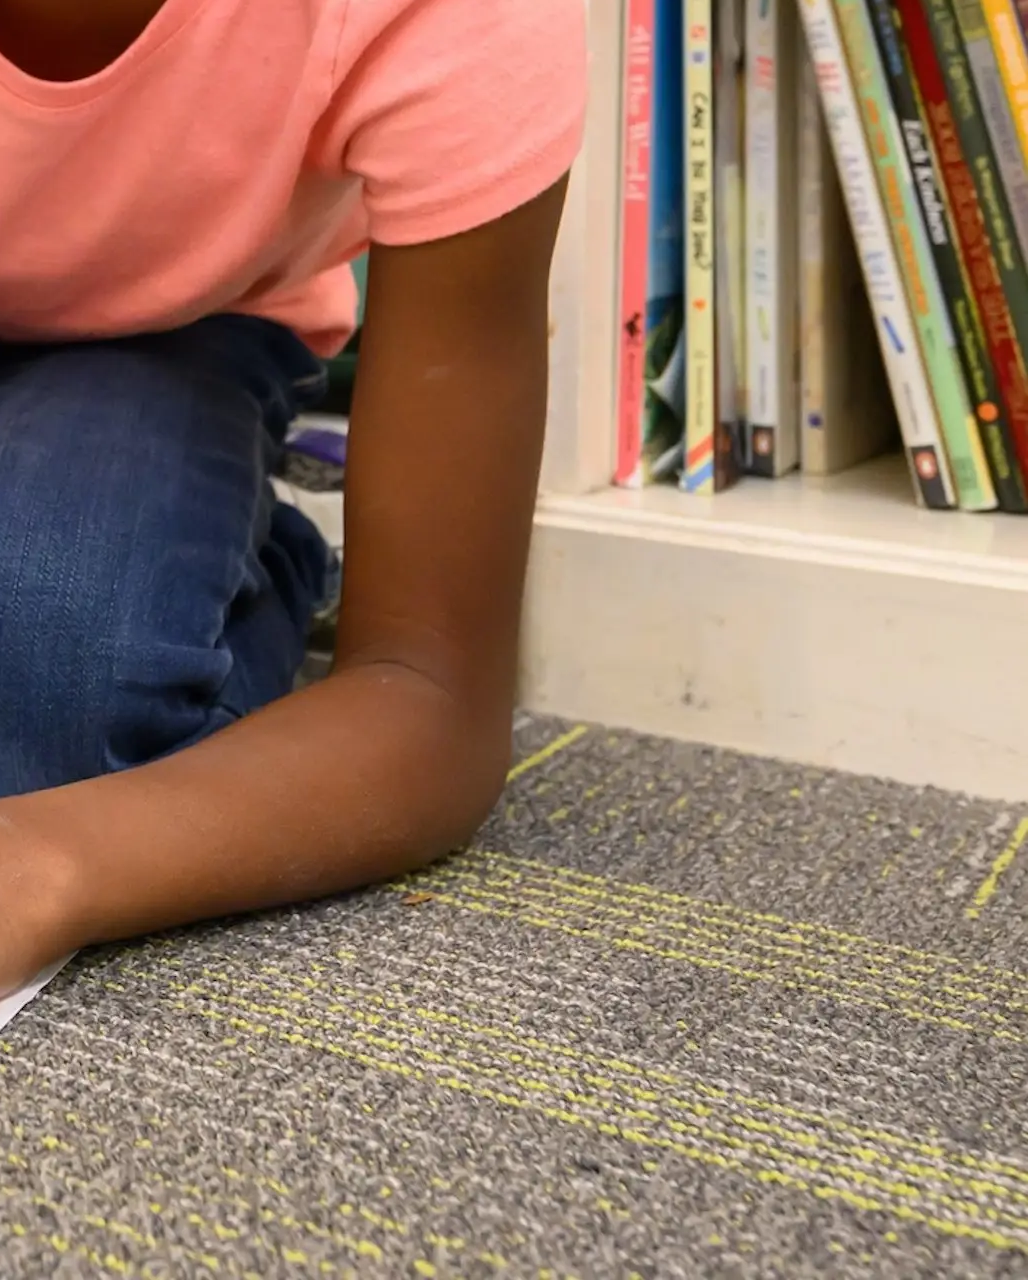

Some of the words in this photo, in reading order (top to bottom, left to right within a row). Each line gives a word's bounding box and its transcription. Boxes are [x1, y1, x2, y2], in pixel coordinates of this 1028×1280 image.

[628, 23, 651, 65] All
[627, 73, 649, 117] the
[691, 91, 705, 129] CAN
[624, 121, 648, 201] World
[899, 116, 932, 165] Each
[911, 161, 953, 248] Kindness
